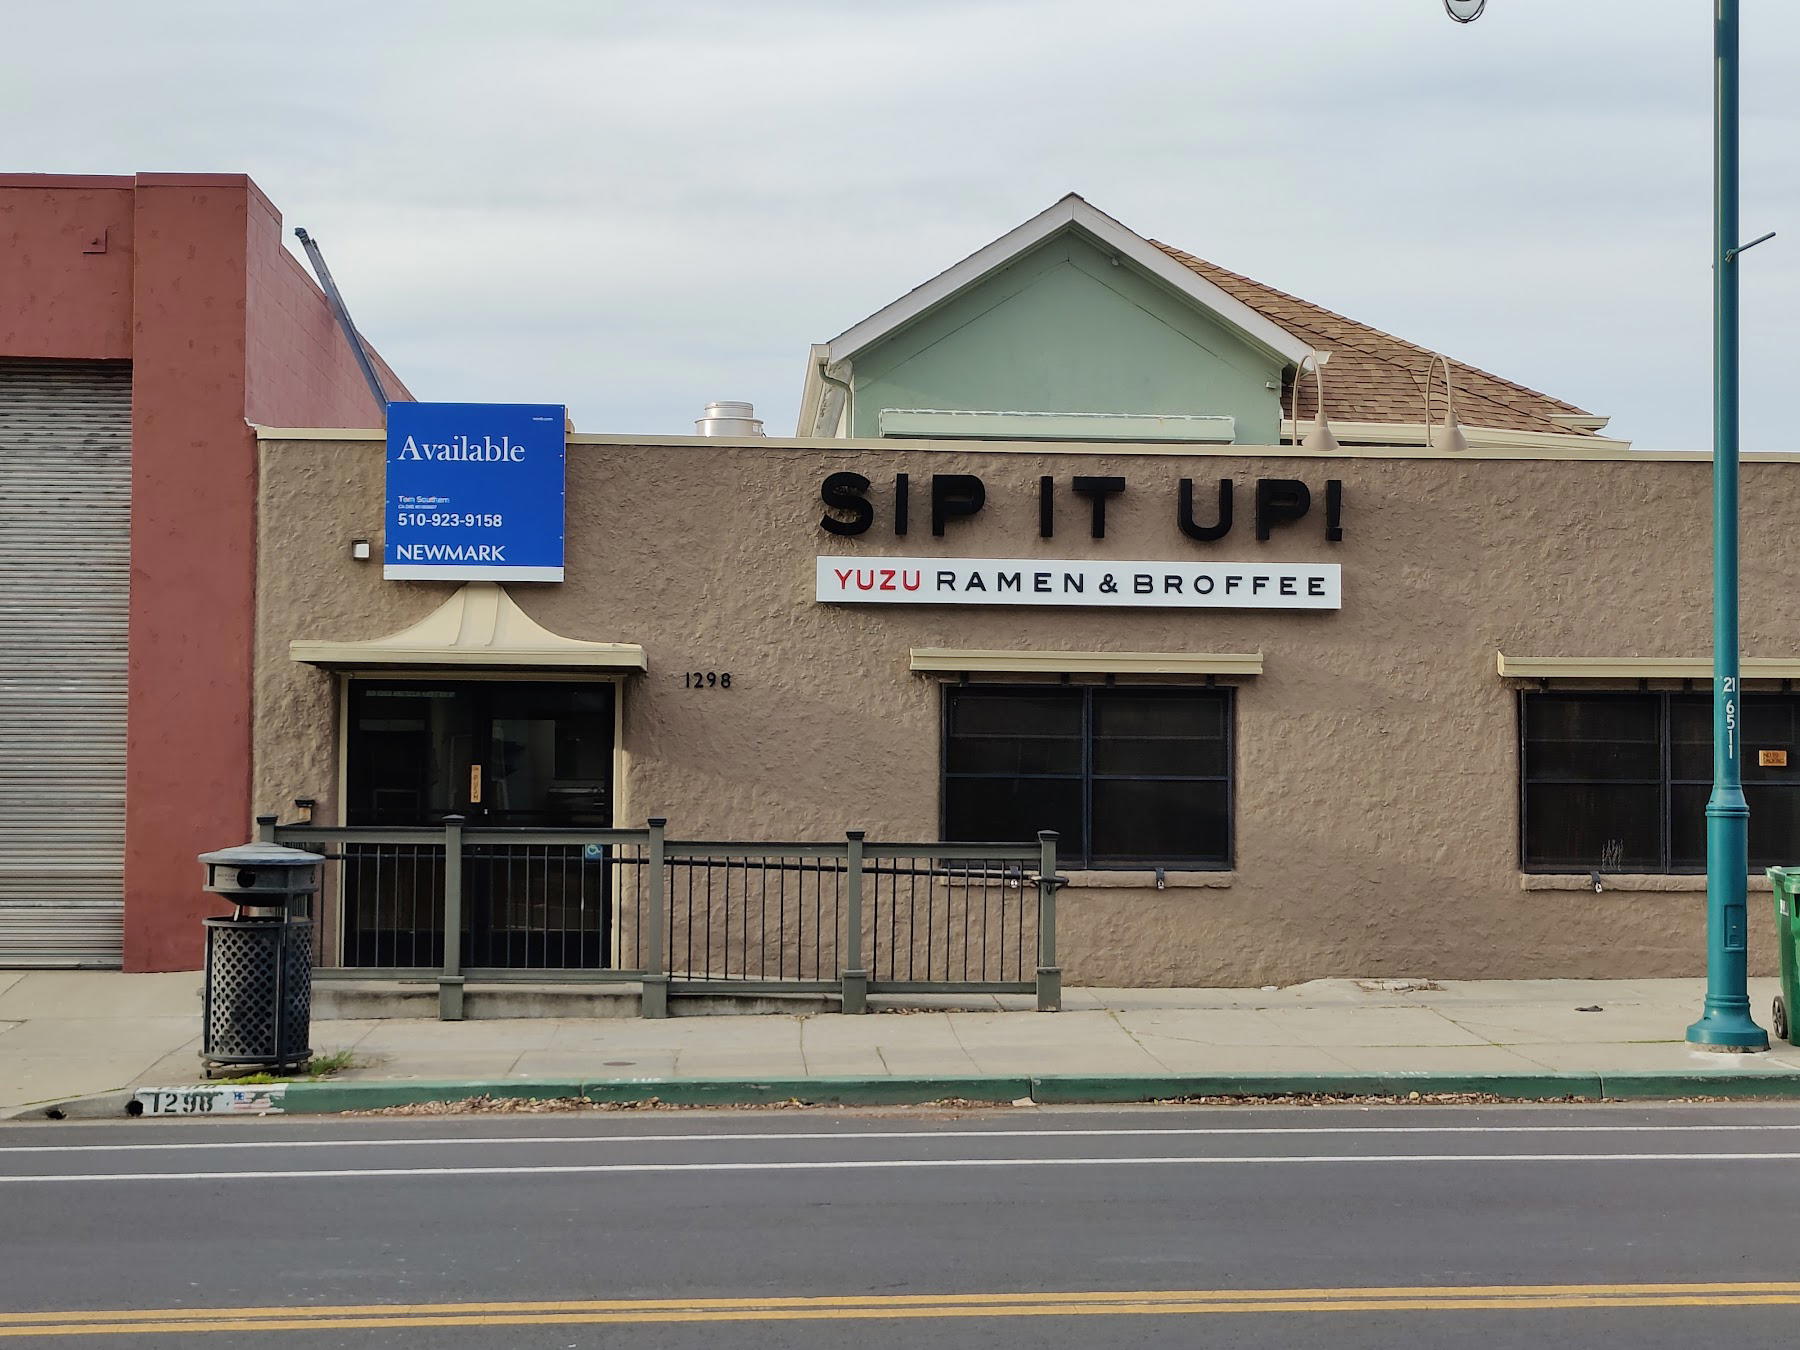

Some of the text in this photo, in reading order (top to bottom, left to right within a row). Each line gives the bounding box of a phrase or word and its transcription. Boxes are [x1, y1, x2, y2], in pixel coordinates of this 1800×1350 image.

[397, 435, 526, 462] Available
[820, 471, 1344, 542] SIP IT UP!
[397, 513, 503, 528] 510-923-9158
[396, 544, 507, 562] NEWMARK
[834, 568, 1326, 597] YUZU RAMEN & BROFFEE
[686, 671, 731, 689] 1298
[1723, 676, 1736, 693] 21
